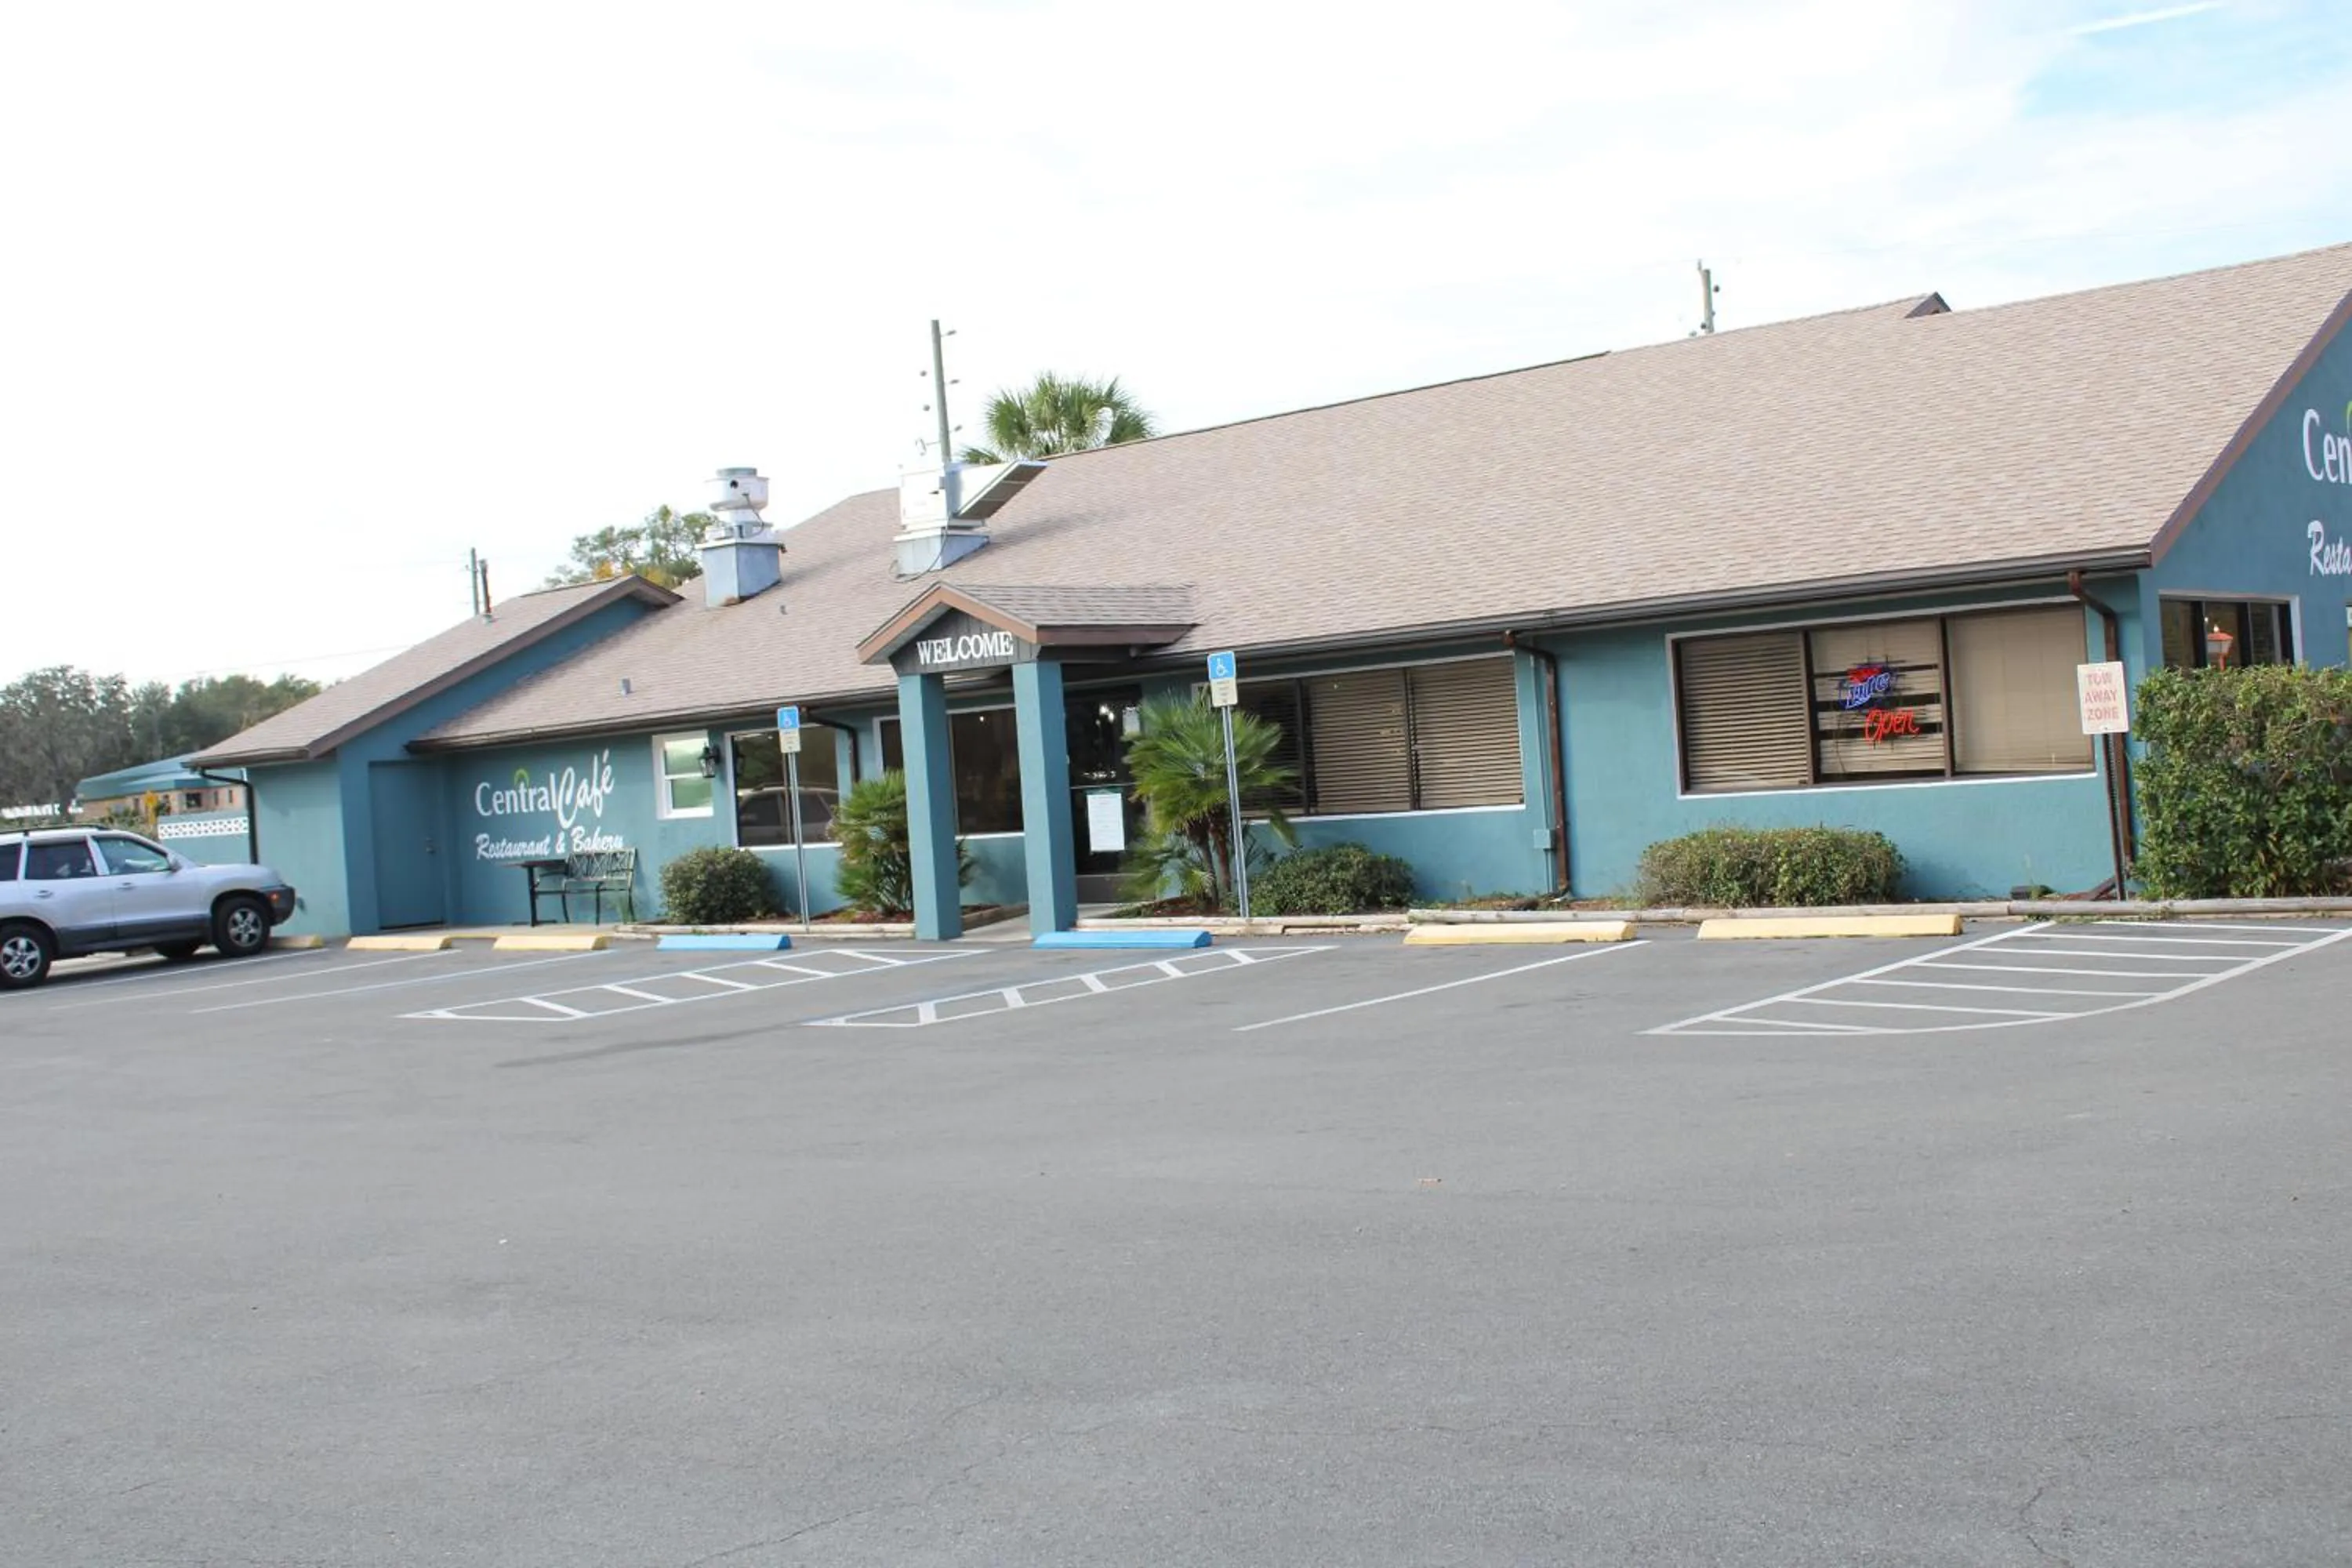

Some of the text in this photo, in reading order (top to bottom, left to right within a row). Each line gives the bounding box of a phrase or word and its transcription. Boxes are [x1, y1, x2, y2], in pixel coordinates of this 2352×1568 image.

[916, 630, 1014, 665] WELCOME
[2086, 672, 2112, 685] TOW
[2085, 689, 2118, 703] AWAY
[1865, 707, 1920, 742] Open
[2087, 706, 2120, 720] ZONE
[475, 748, 615, 829] Central Café
[476, 833, 550, 860] Restaurant
[556, 831, 565, 854] &
